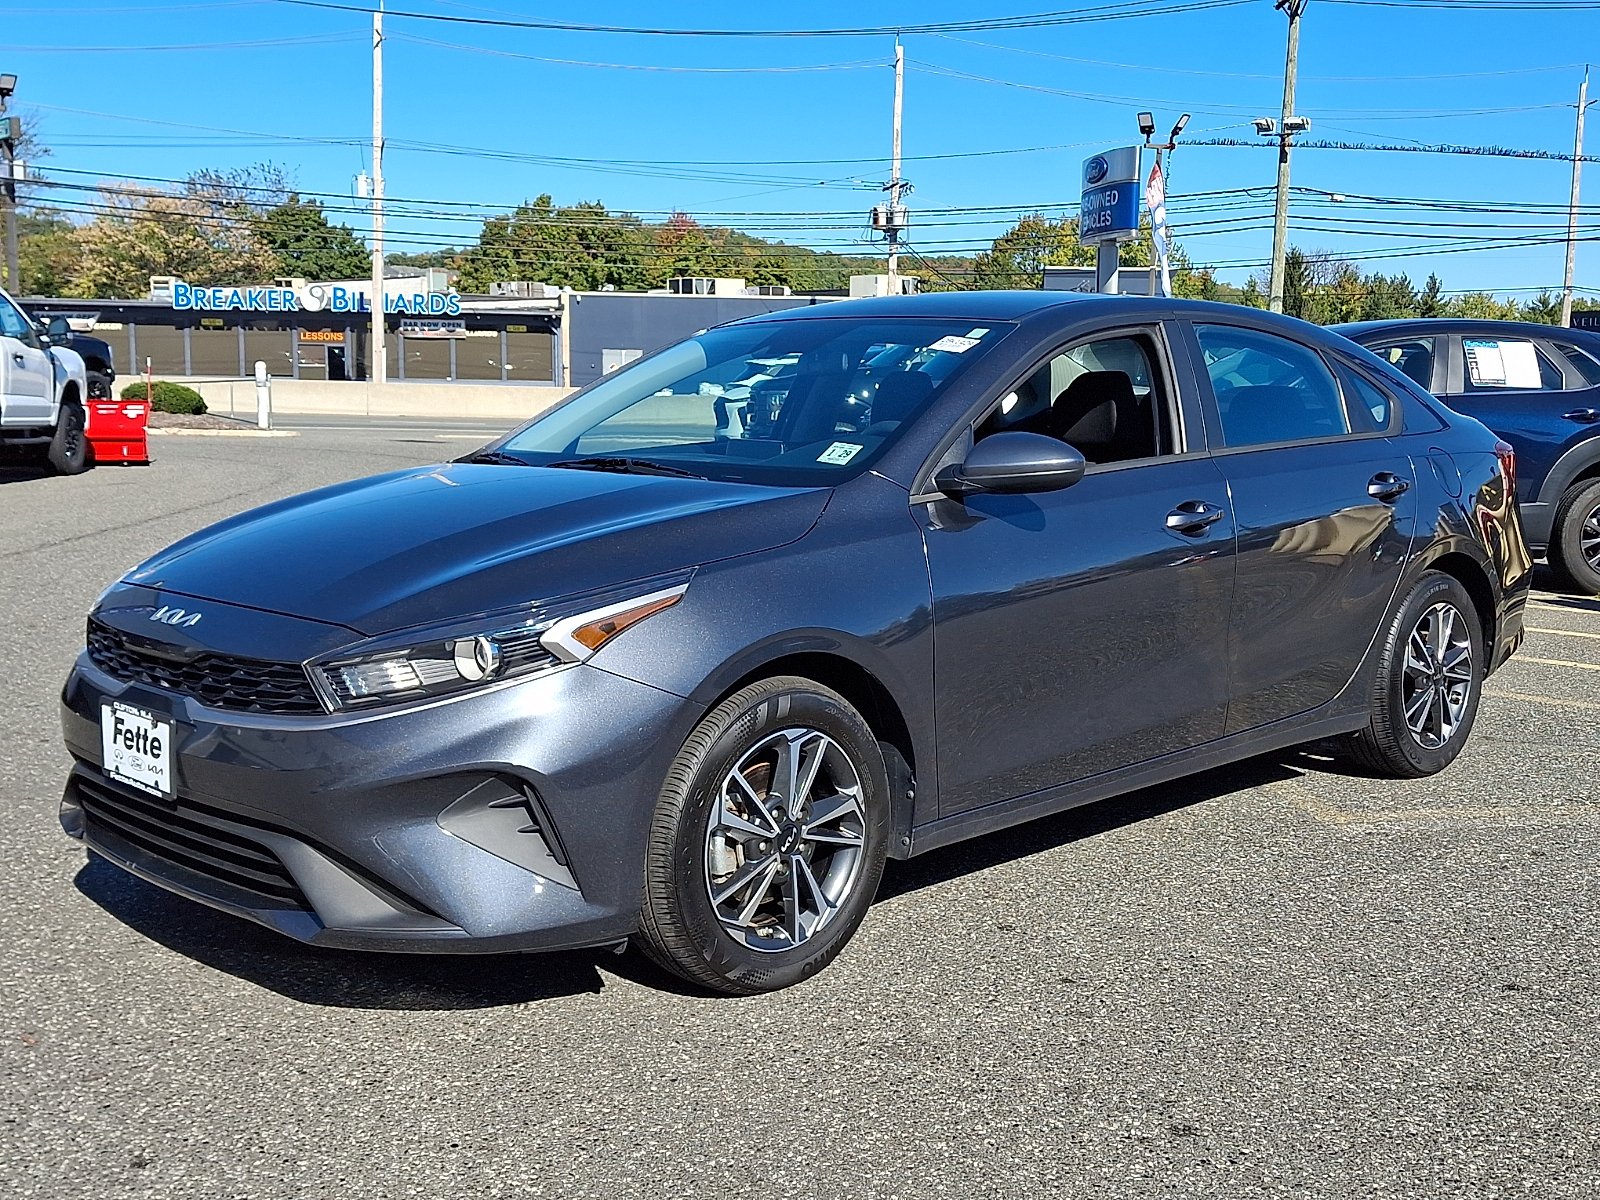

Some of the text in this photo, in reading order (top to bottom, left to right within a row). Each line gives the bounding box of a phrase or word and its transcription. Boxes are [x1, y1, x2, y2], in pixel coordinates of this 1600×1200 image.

[173, 282, 461, 315] BREAKER BILIARDS
[420, 321, 439, 329] NOW
[441, 321, 461, 329] OPEN
[300, 331, 344, 341] LESSONS
[113, 716, 162, 759] Fette
